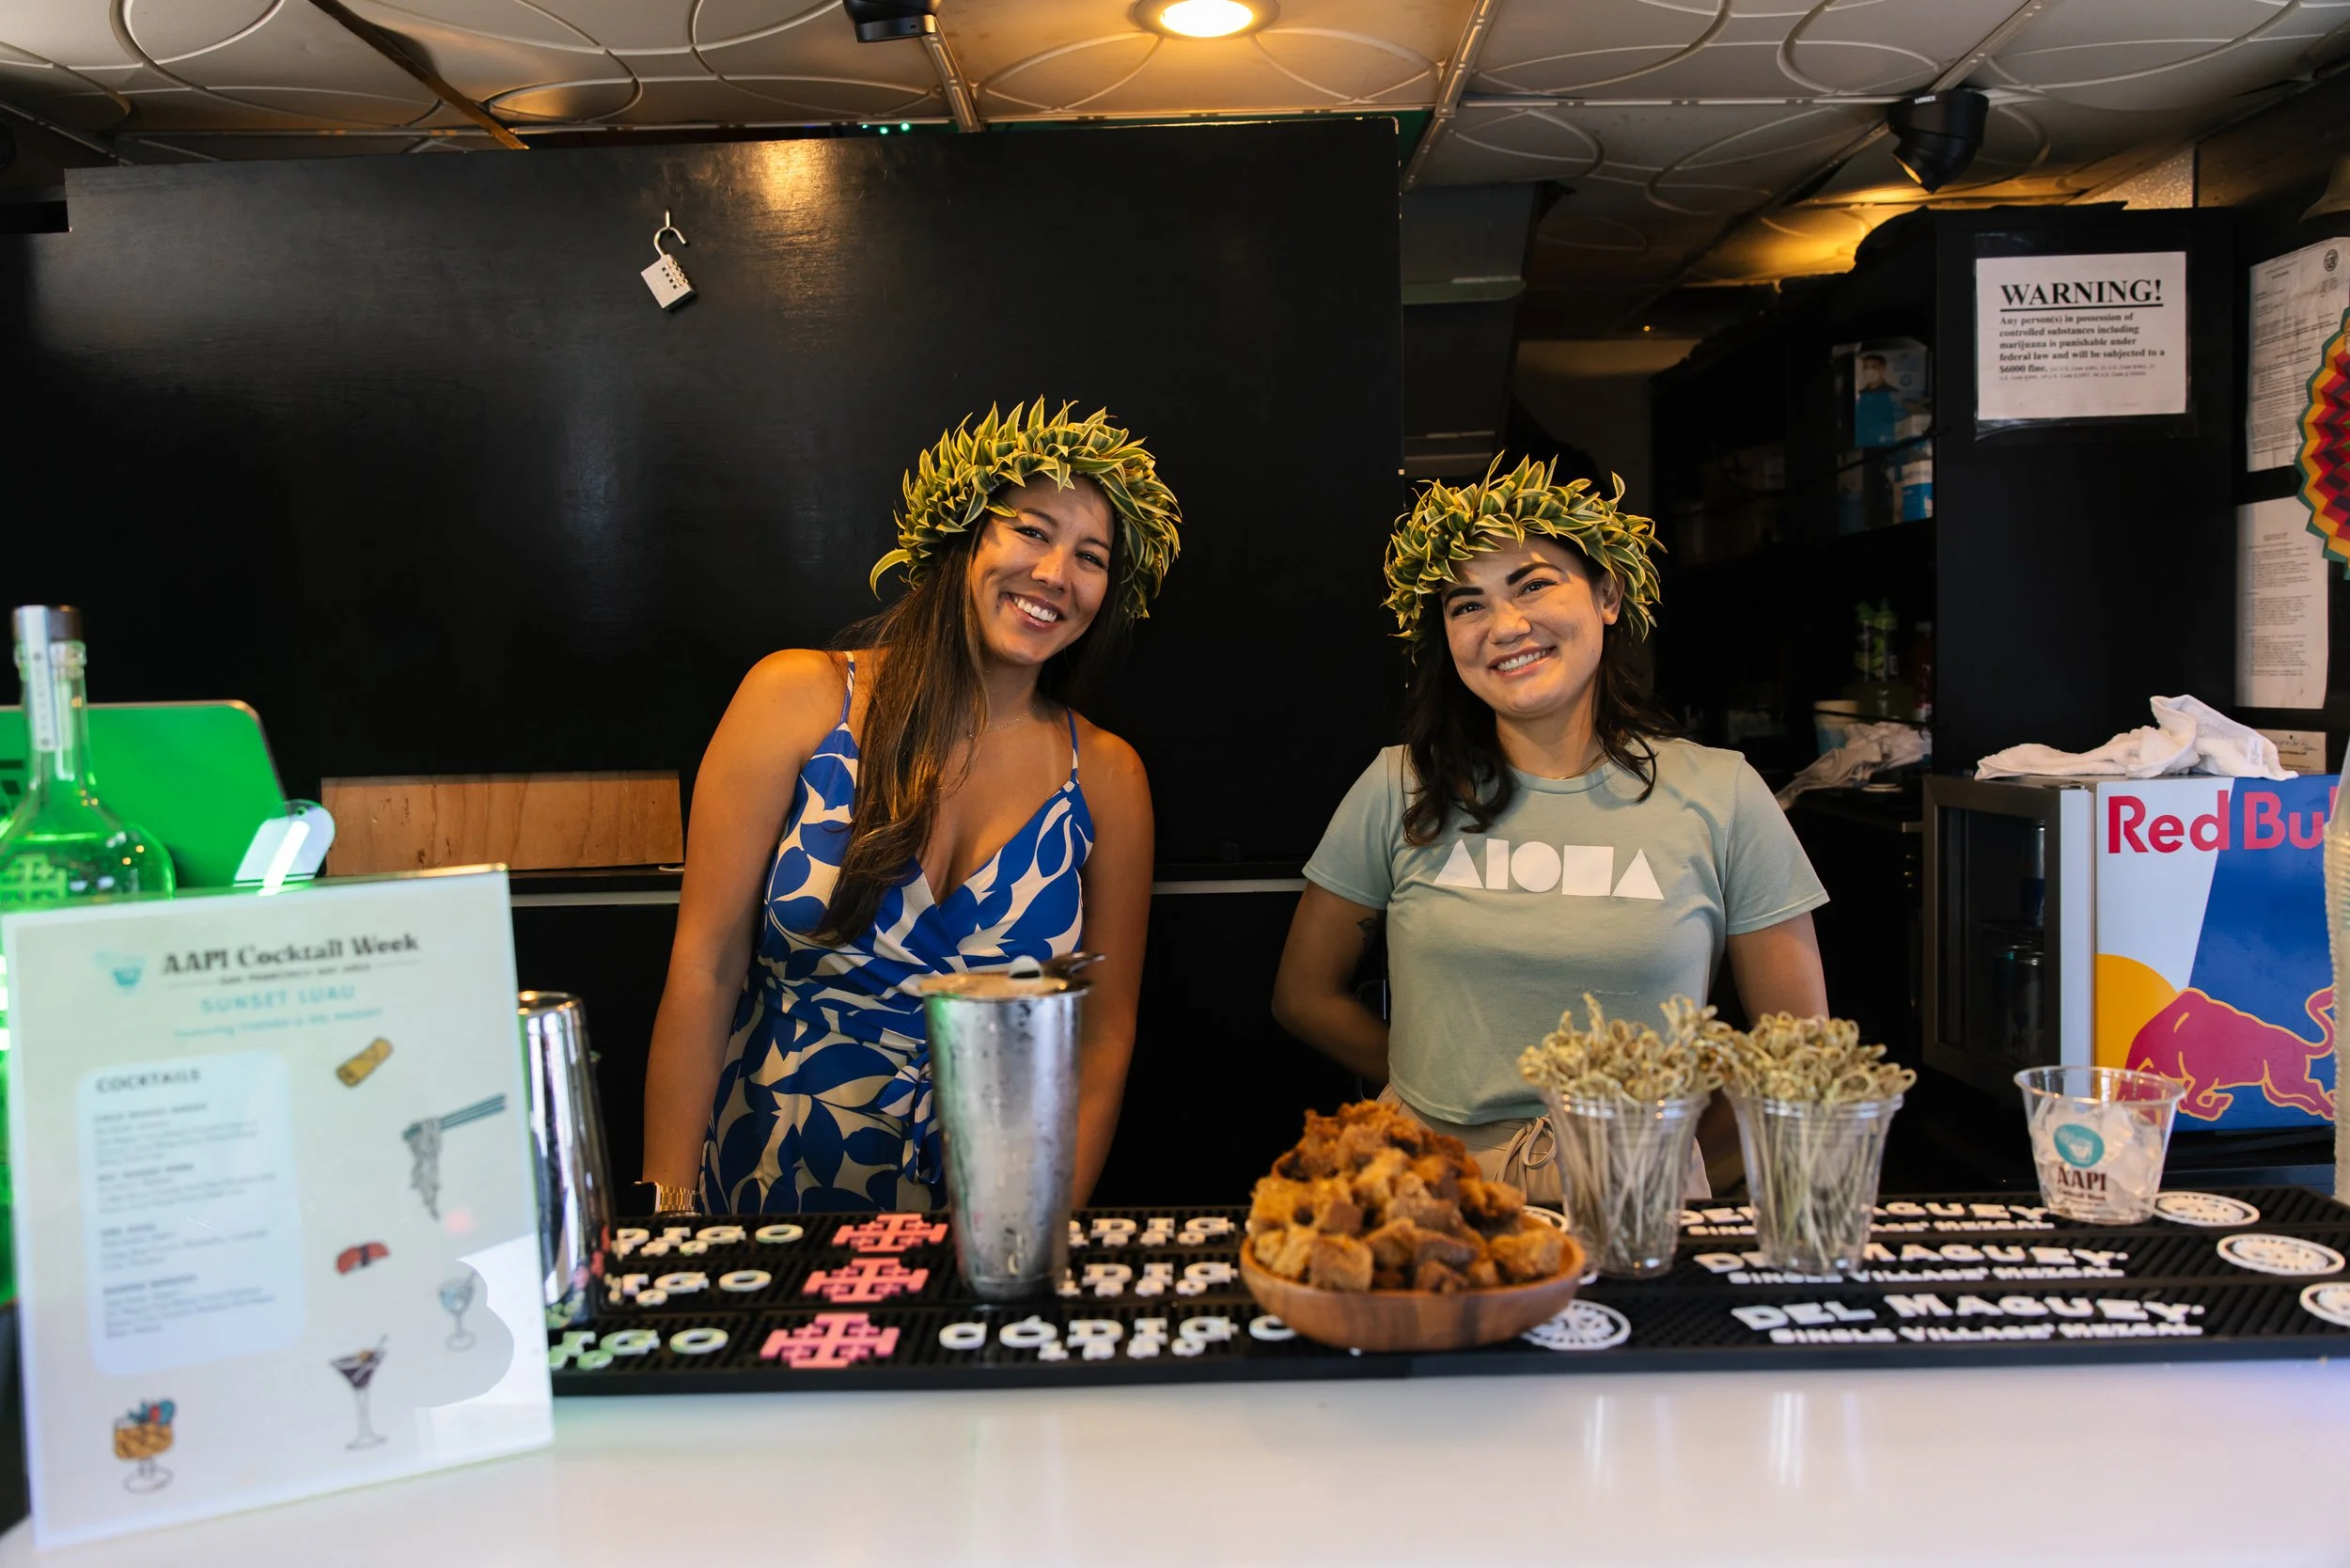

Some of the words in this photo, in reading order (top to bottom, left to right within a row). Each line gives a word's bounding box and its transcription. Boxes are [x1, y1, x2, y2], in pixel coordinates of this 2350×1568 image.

[2000, 279, 2162, 306] WARNING!
[1999, 317, 2018, 327] Any
[2021, 315, 2062, 326] person(s)
[2064, 315, 2074, 323] in
[2076, 313, 2122, 324] possession
[2124, 312, 2135, 321] of
[1999, 327, 2045, 337] controlled
[2047, 325, 2095, 337] substances
[2097, 324, 2139, 336] including
[1999, 339, 2046, 351] marijuana
[2049, 339, 2057, 348] is
[2059, 337, 2108, 349] punishable
[2110, 337, 2137, 346] under
[1999, 352, 2031, 361] federal
[2033, 351, 2049, 360] law
[2052, 351, 2070, 359] and
[2072, 350, 2089, 358] will
[2091, 350, 2101, 358] be
[2103, 349, 2145, 360] subjected
[2148, 349, 2157, 357] to
[2107, 791, 2231, 854] Red
[2244, 786, 2338, 851] Bu
[238, 937, 344, 968] Cocktail
[352, 933, 420, 957] Week
[200, 990, 288, 1014] SUNSET
[2057, 1165, 2107, 1191] AAPI
[1731, 1301, 1876, 1330] DEL
